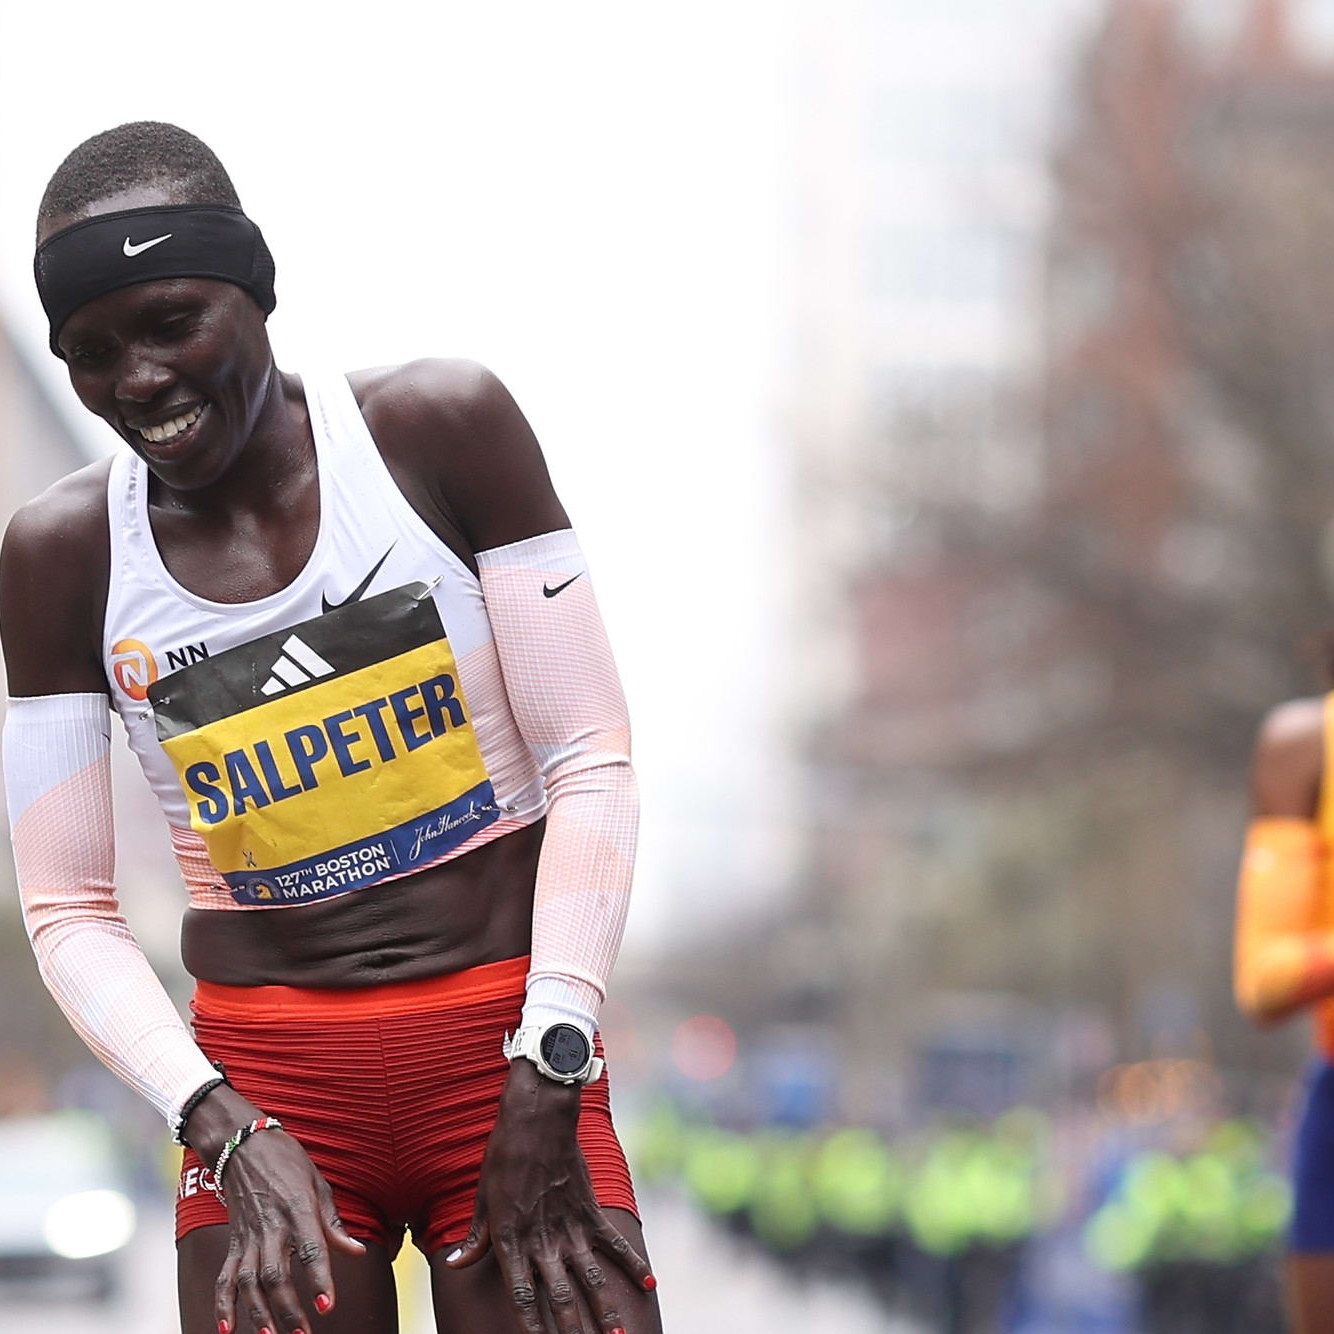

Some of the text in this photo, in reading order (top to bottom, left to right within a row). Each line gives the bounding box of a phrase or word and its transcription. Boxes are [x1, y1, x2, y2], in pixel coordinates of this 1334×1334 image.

[184, 673, 467, 825] SALPETER
[282, 857, 391, 899] MARATHON
[315, 843, 385, 877] BOSTON
